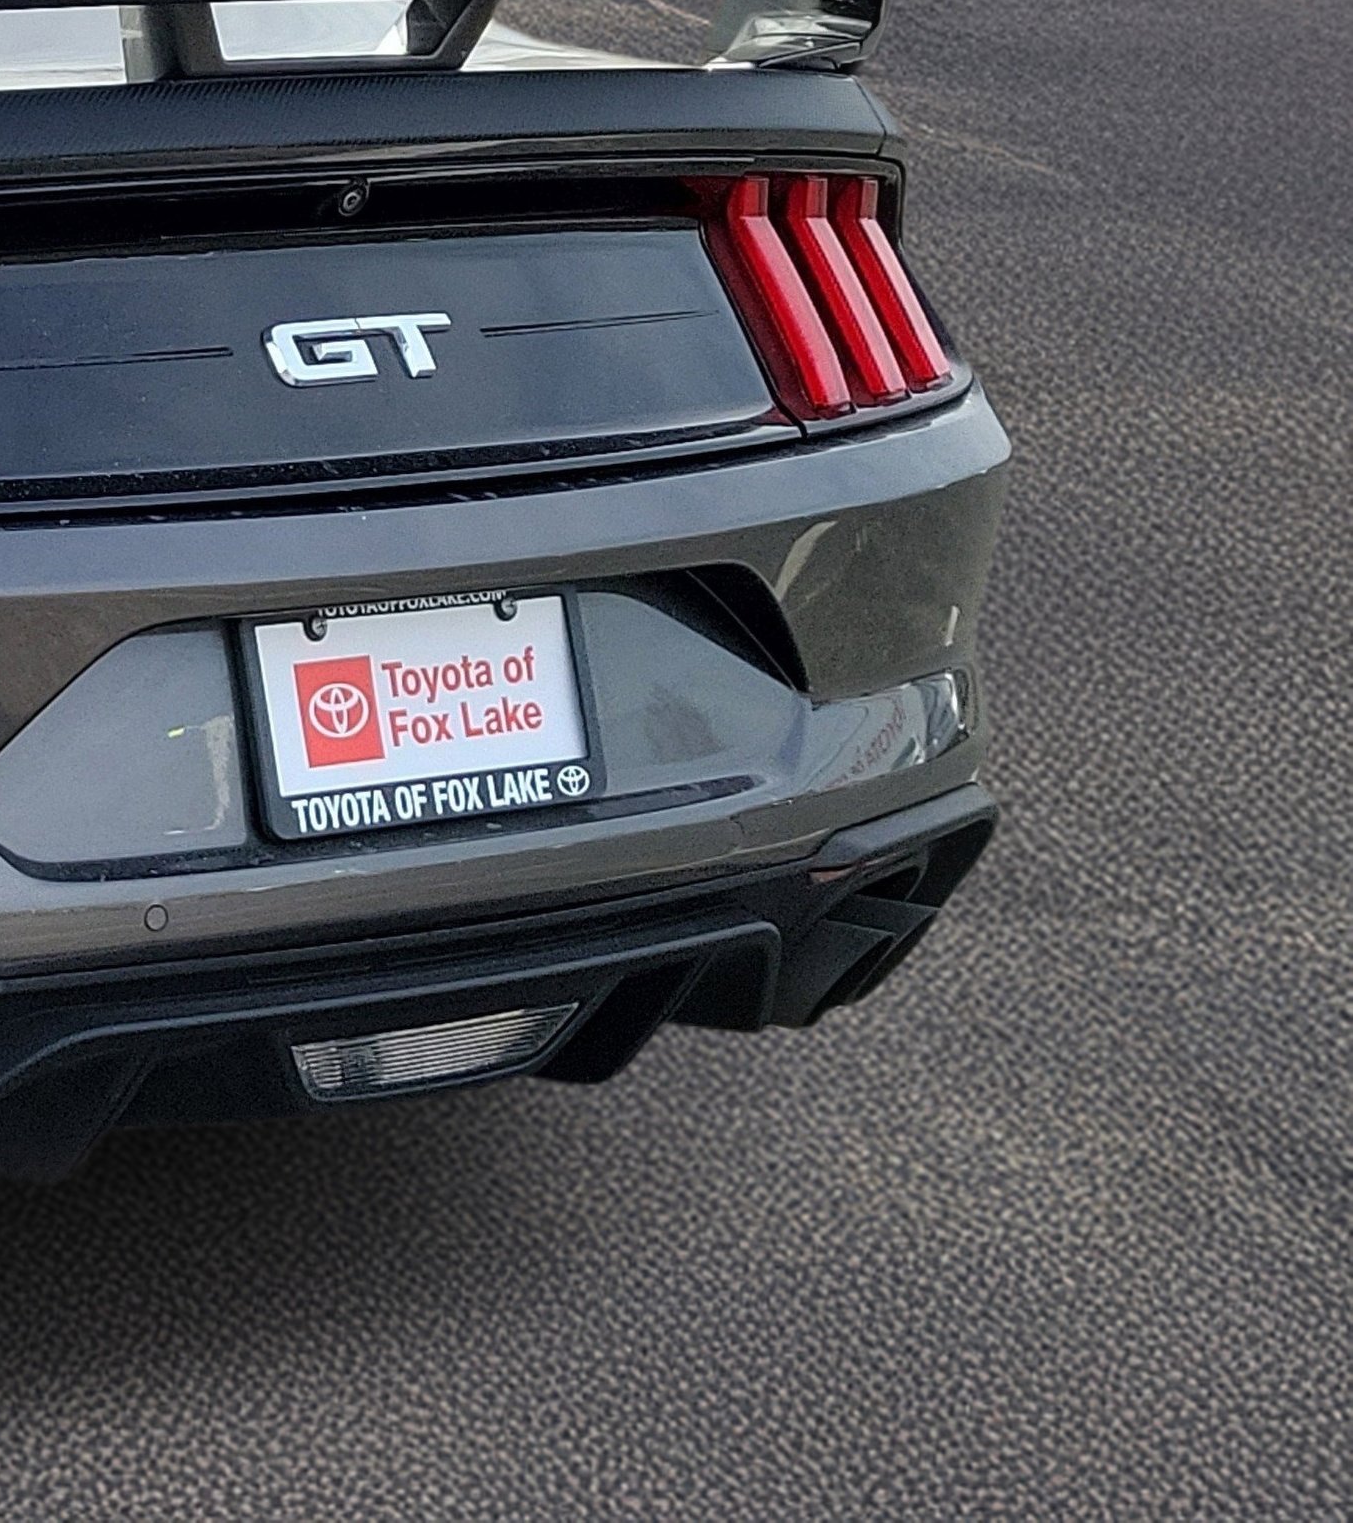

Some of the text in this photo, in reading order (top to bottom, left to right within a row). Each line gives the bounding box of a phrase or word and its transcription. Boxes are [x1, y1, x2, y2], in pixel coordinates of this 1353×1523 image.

[261, 312, 452, 387] GT
[381, 646, 536, 704] Toyota of
[387, 697, 543, 748] Fox Lake
[291, 768, 553, 834] TOYOTA OF FOX LAKE
